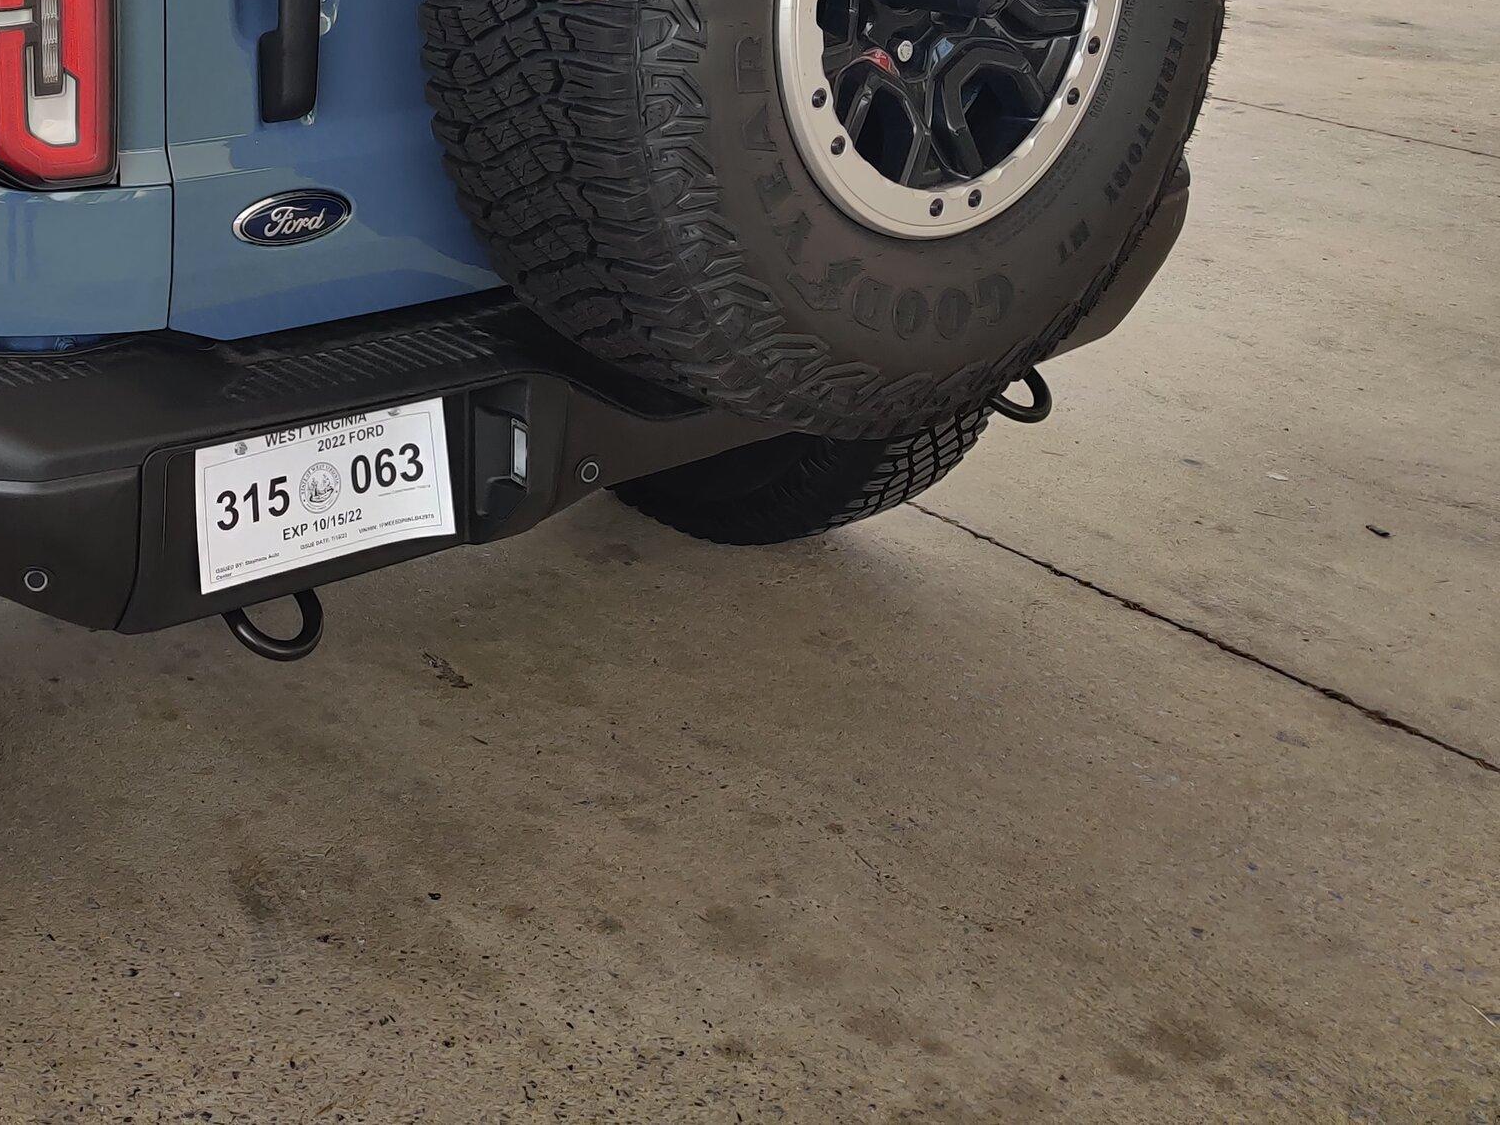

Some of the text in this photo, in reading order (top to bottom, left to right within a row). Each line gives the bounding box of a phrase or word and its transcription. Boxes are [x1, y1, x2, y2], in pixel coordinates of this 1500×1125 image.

[264, 202, 327, 237] Ford
[265, 414, 367, 448] WEST VIRGINIA
[317, 424, 384, 452] 2022 FORD
[350, 442, 424, 494] 063
[216, 475, 290, 531] 315
[283, 508, 363, 541] EXP 10/15/22
